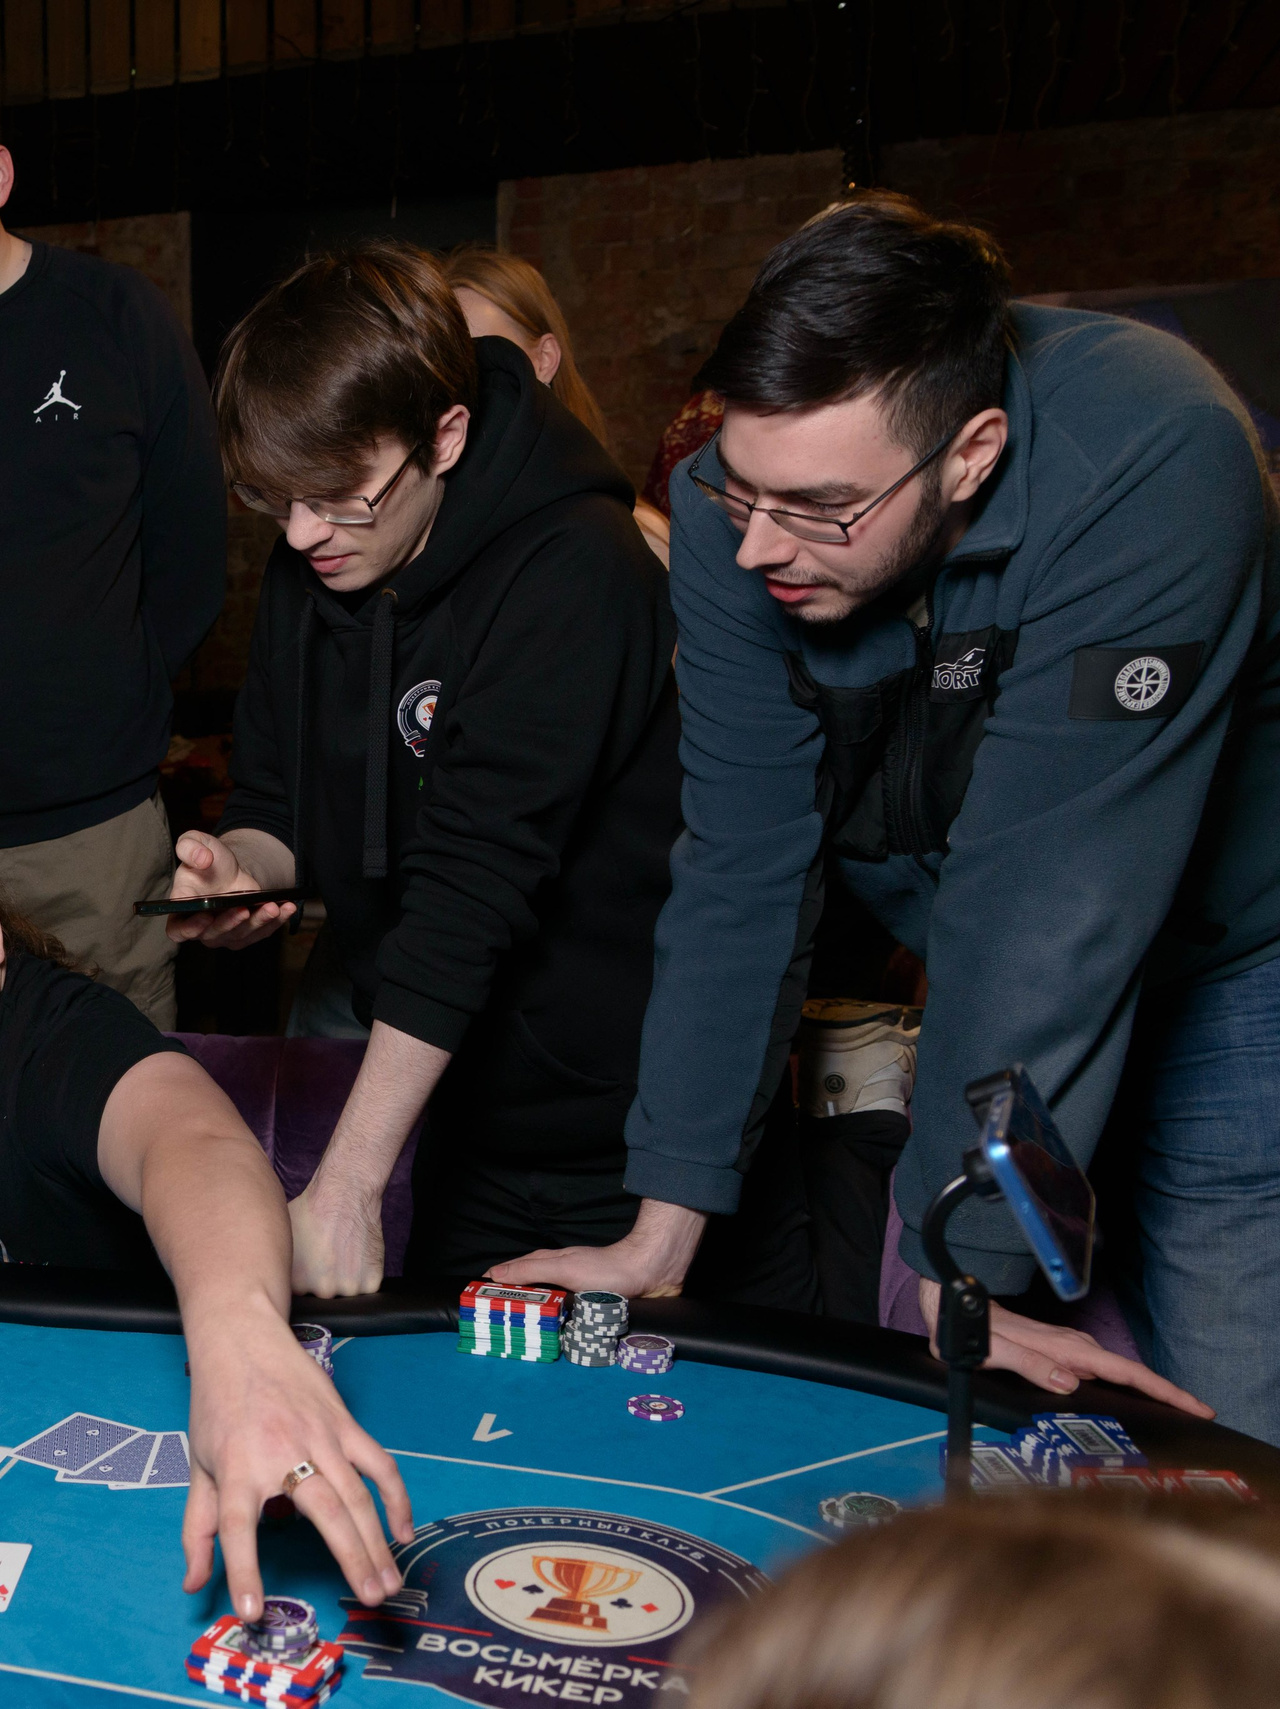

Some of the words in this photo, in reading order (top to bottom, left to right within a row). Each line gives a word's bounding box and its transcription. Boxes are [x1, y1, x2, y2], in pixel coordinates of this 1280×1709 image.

[35, 412, 79, 424] AIR
[485, 1517, 631, 1534] ПОКЕРНЫЙ
[640, 1531, 706, 1560] КЛУБ
[473, 1665, 624, 1706] КИКЕР
